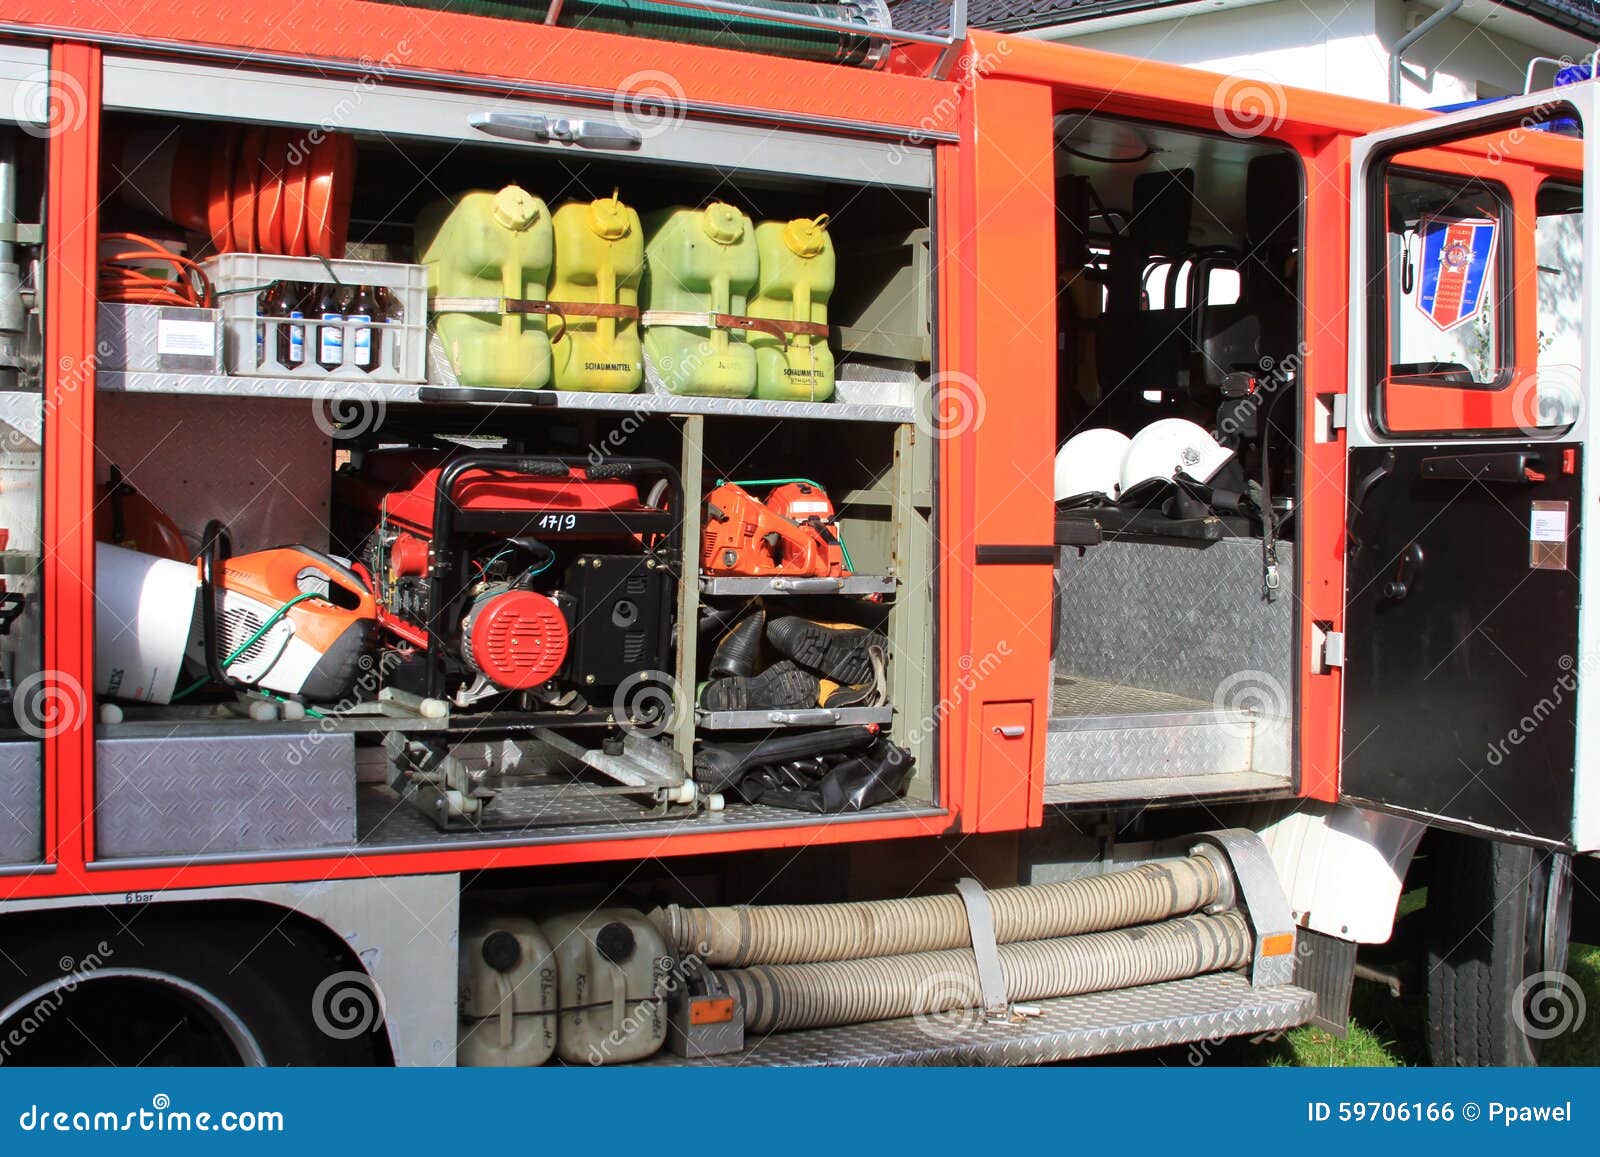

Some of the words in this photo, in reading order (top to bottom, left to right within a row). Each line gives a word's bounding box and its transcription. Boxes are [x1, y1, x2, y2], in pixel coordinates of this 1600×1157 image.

[584, 362, 632, 372] SCHAUMMITTEL
[783, 368, 825, 378] SCHAUMMTTEL
[539, 514, 576, 532] 17/9
[125, 891, 133, 903] 6
[135, 891, 153, 902] bar
